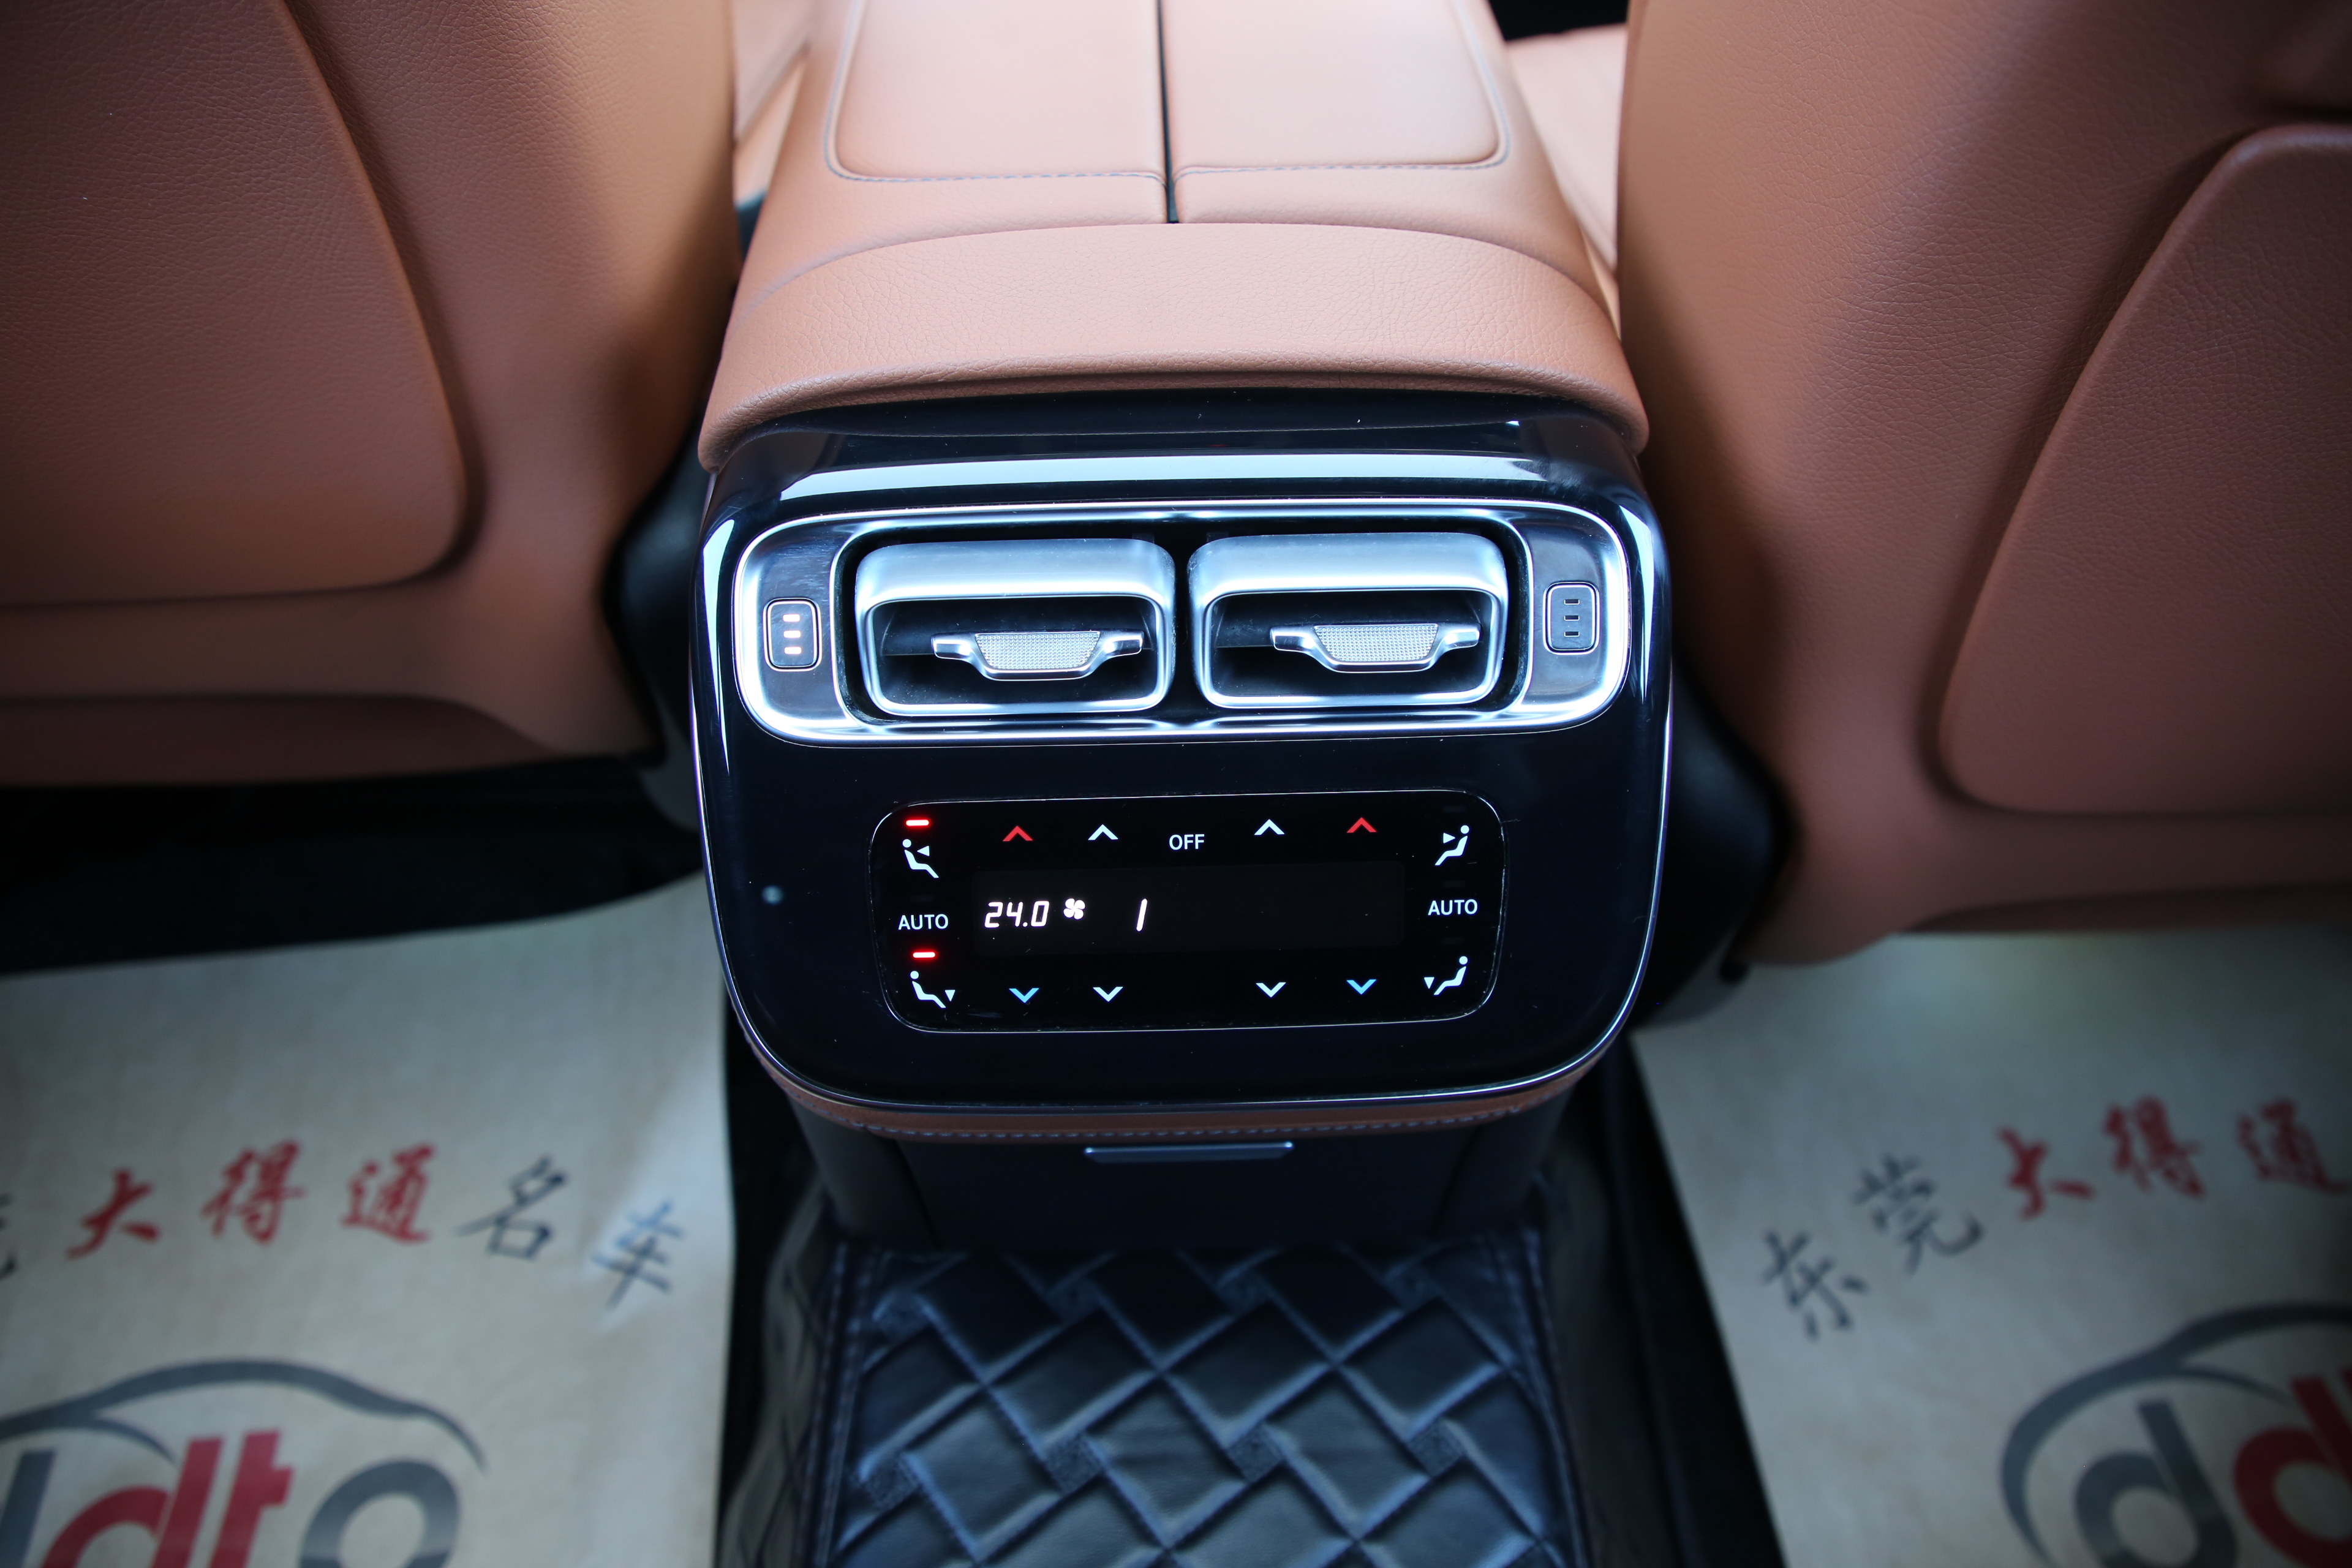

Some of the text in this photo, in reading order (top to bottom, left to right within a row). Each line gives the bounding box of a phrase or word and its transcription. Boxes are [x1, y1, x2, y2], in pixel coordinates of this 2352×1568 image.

[1168, 834, 1205, 851] OFF
[984, 900, 1050, 929] 24.0
[1427, 899, 1479, 916] AUTO
[897, 913, 949, 931] AUTO
[0, 1140, 684, 1311] 大得通名车
